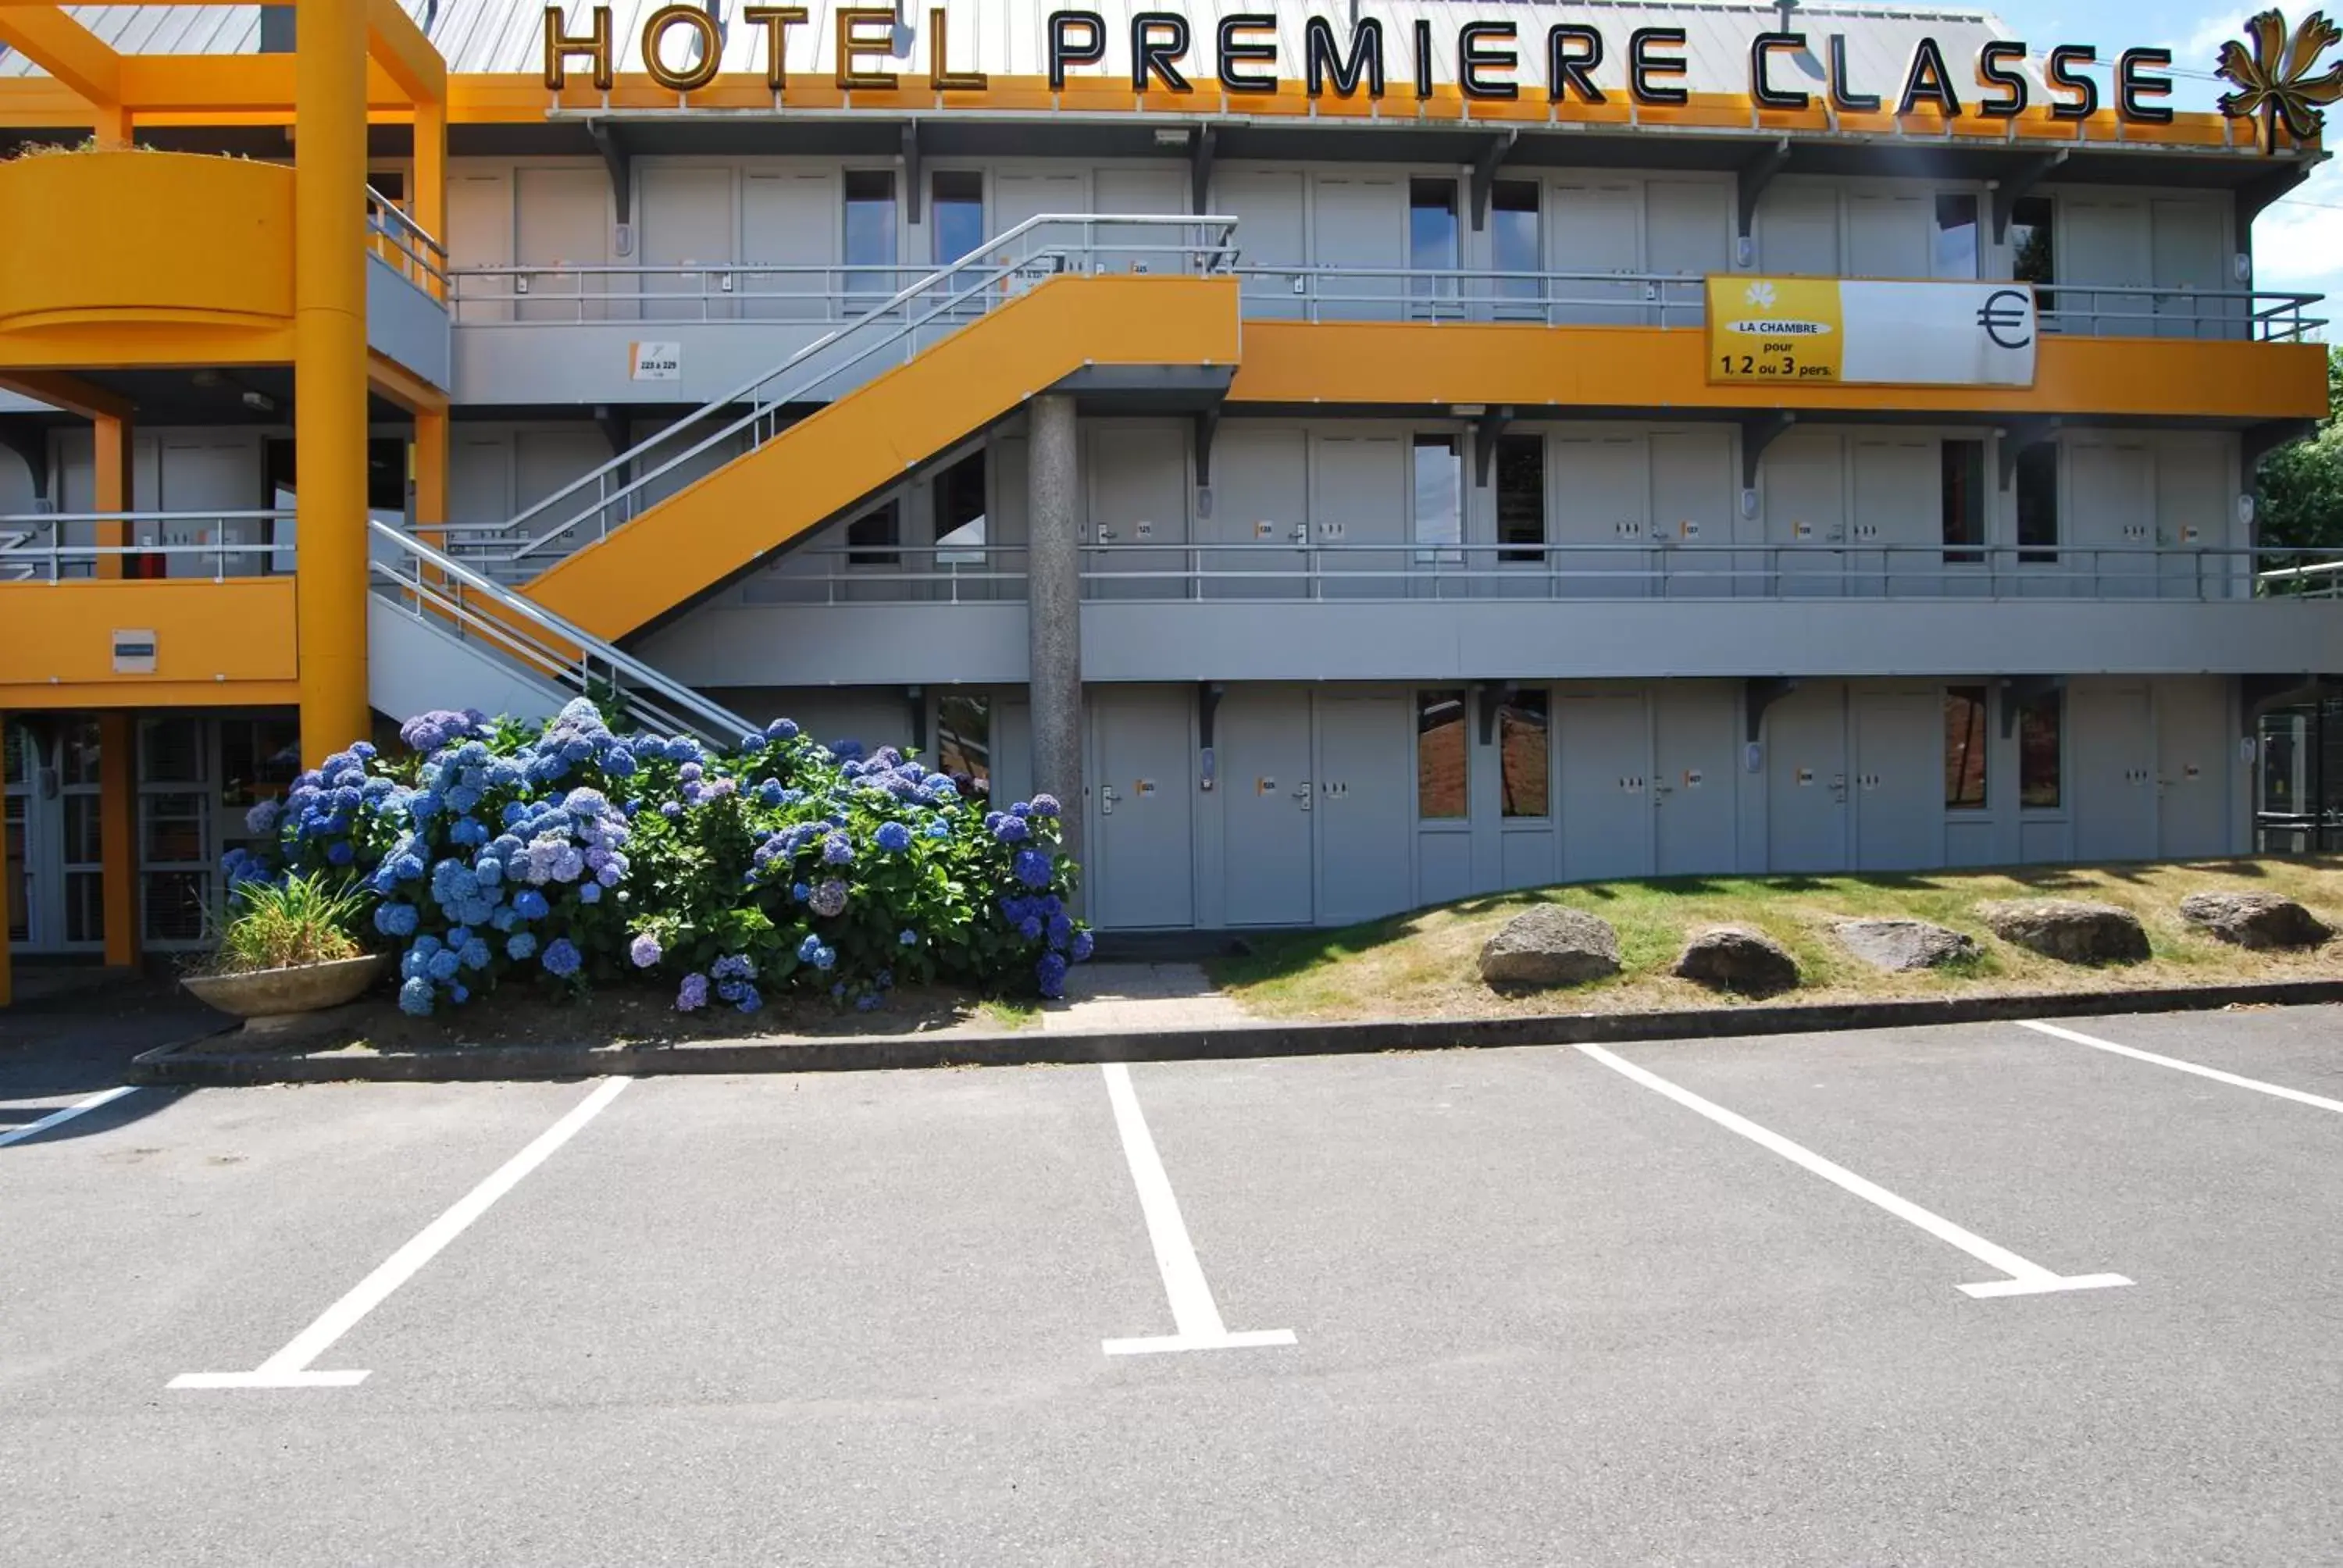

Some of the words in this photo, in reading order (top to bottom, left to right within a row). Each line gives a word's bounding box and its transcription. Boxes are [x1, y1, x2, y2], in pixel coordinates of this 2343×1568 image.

[545, 5, 987, 91] HOTEL
[1048, 10, 1688, 105] PREMIERE
[1750, 32, 2174, 123] CLASSE
[1739, 323, 1756, 332] LA
[1760, 323, 1817, 333] CHAMBRE
[1763, 343, 1793, 354] pour
[1741, 355, 1754, 374] 2
[1759, 365, 1777, 374] ou
[1781, 357, 1795, 374] 3
[1799, 365, 1831, 377] pers.
